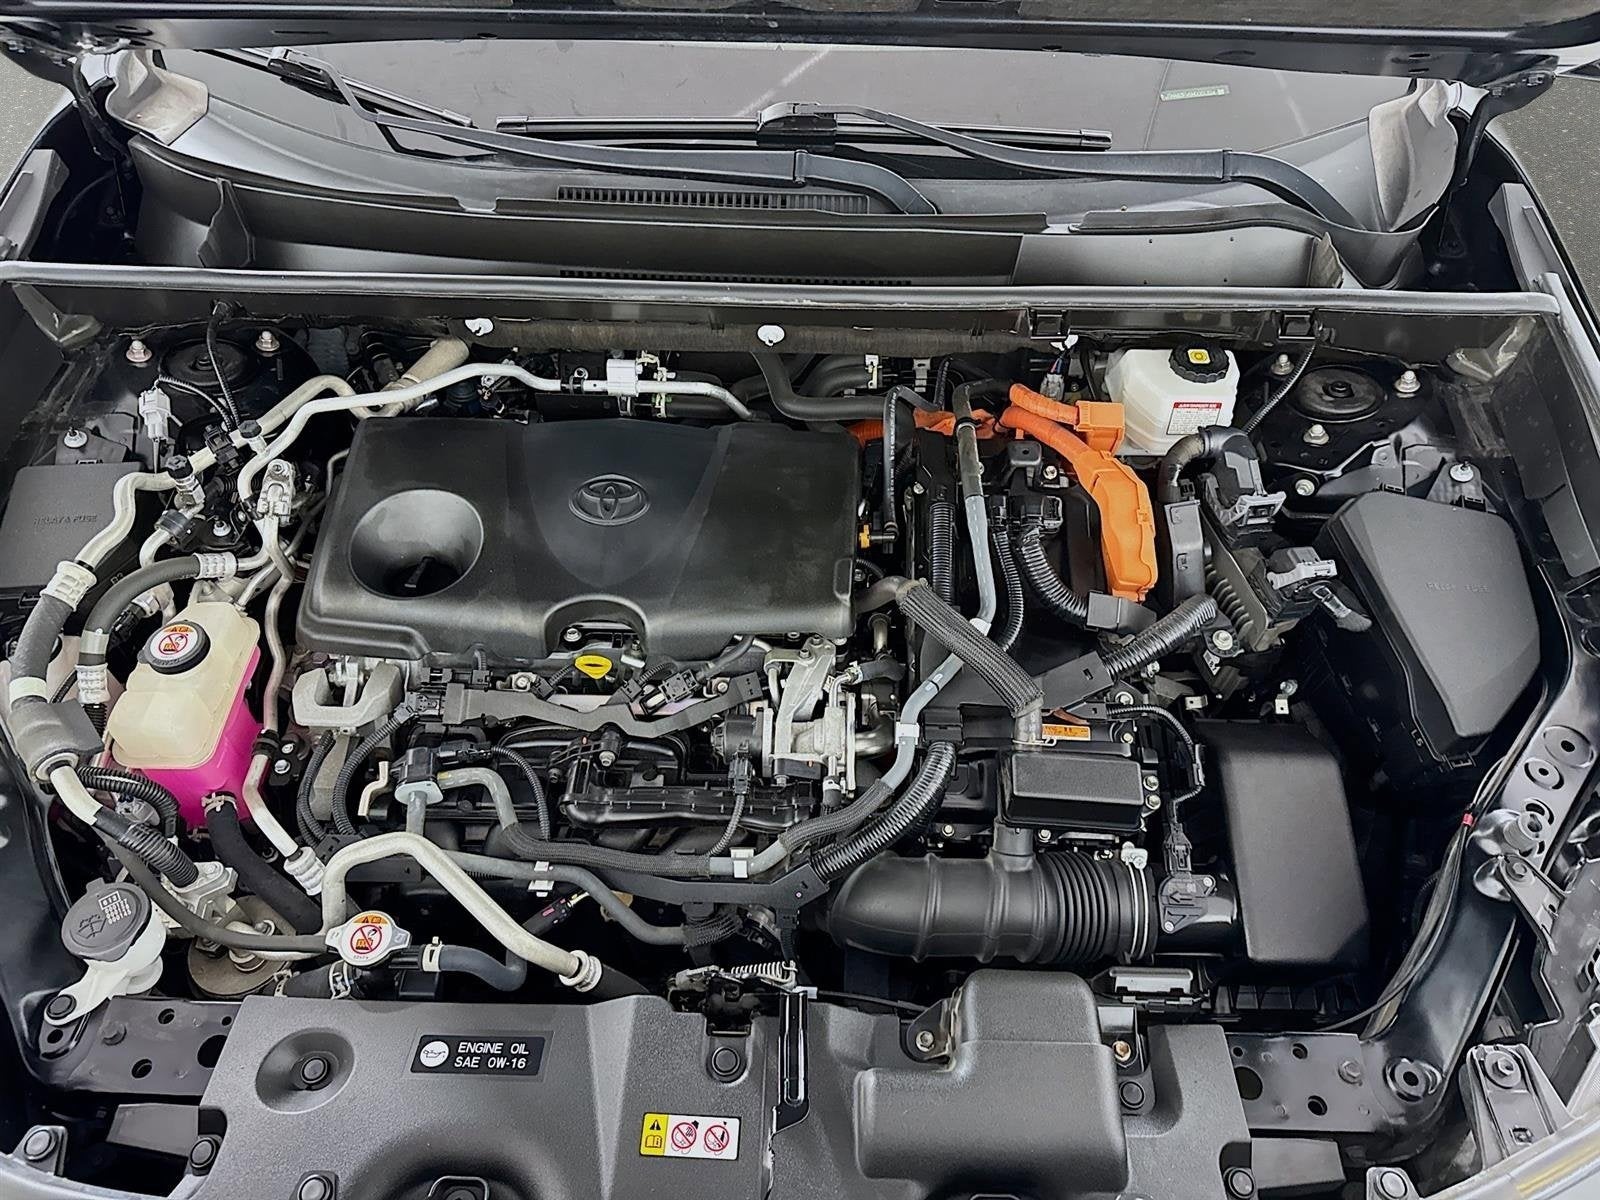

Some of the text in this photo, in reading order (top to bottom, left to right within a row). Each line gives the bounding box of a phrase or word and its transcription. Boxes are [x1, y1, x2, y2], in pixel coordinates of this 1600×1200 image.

[457, 1041, 529, 1055] ENGINE OIL
[454, 1056, 526, 1069] SAE 0W-16
